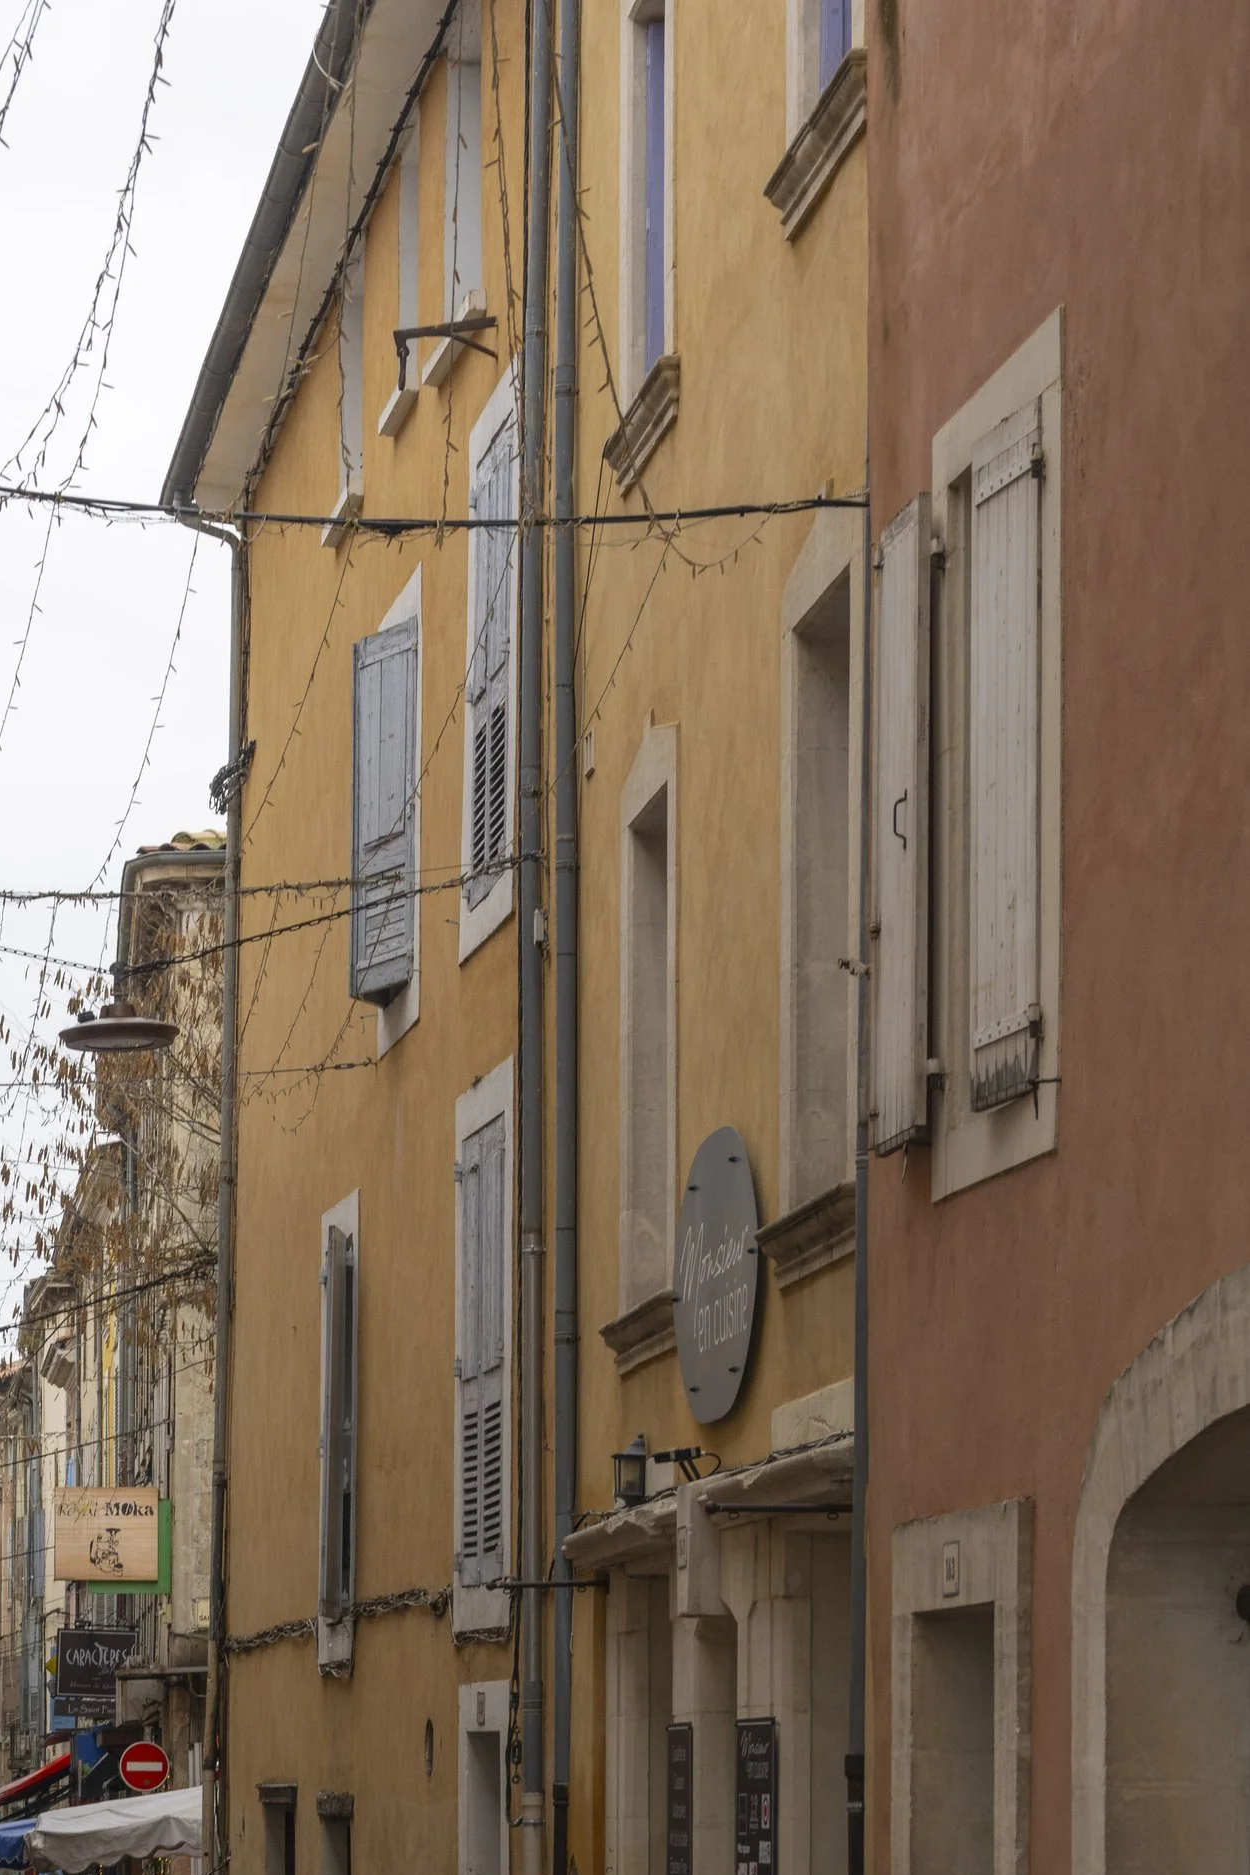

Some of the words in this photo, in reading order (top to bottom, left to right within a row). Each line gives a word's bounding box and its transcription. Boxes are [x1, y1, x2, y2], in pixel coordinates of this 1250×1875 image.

[679, 1222, 748, 1338] Monsieur
[699, 1304, 711, 1353] en
[713, 1278, 748, 1346] cuisine
